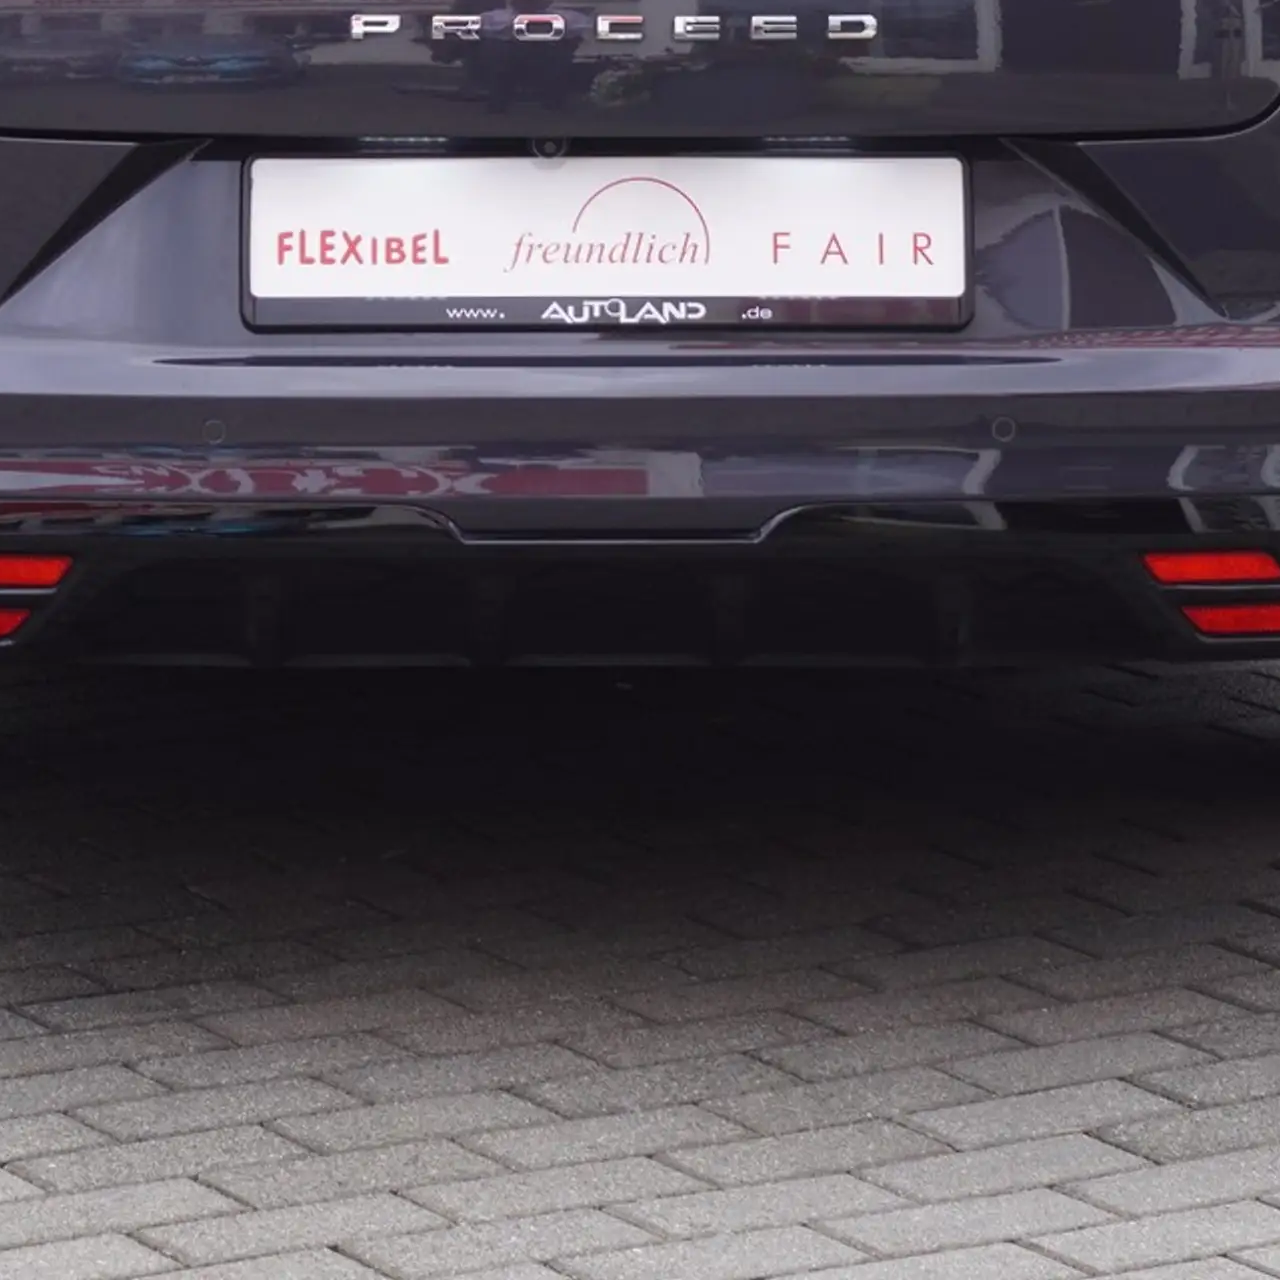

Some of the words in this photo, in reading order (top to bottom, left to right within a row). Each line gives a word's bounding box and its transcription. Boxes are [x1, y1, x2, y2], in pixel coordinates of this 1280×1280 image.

[350, 14, 878, 41] PROCEED
[277, 227, 450, 265] FLEXIBEL
[503, 230, 700, 273] freundlich
[773, 231, 934, 265] FAIR
[446, 306, 507, 320] www.
[541, 297, 707, 324] AUTOLAND
[741, 305, 774, 320] .de
